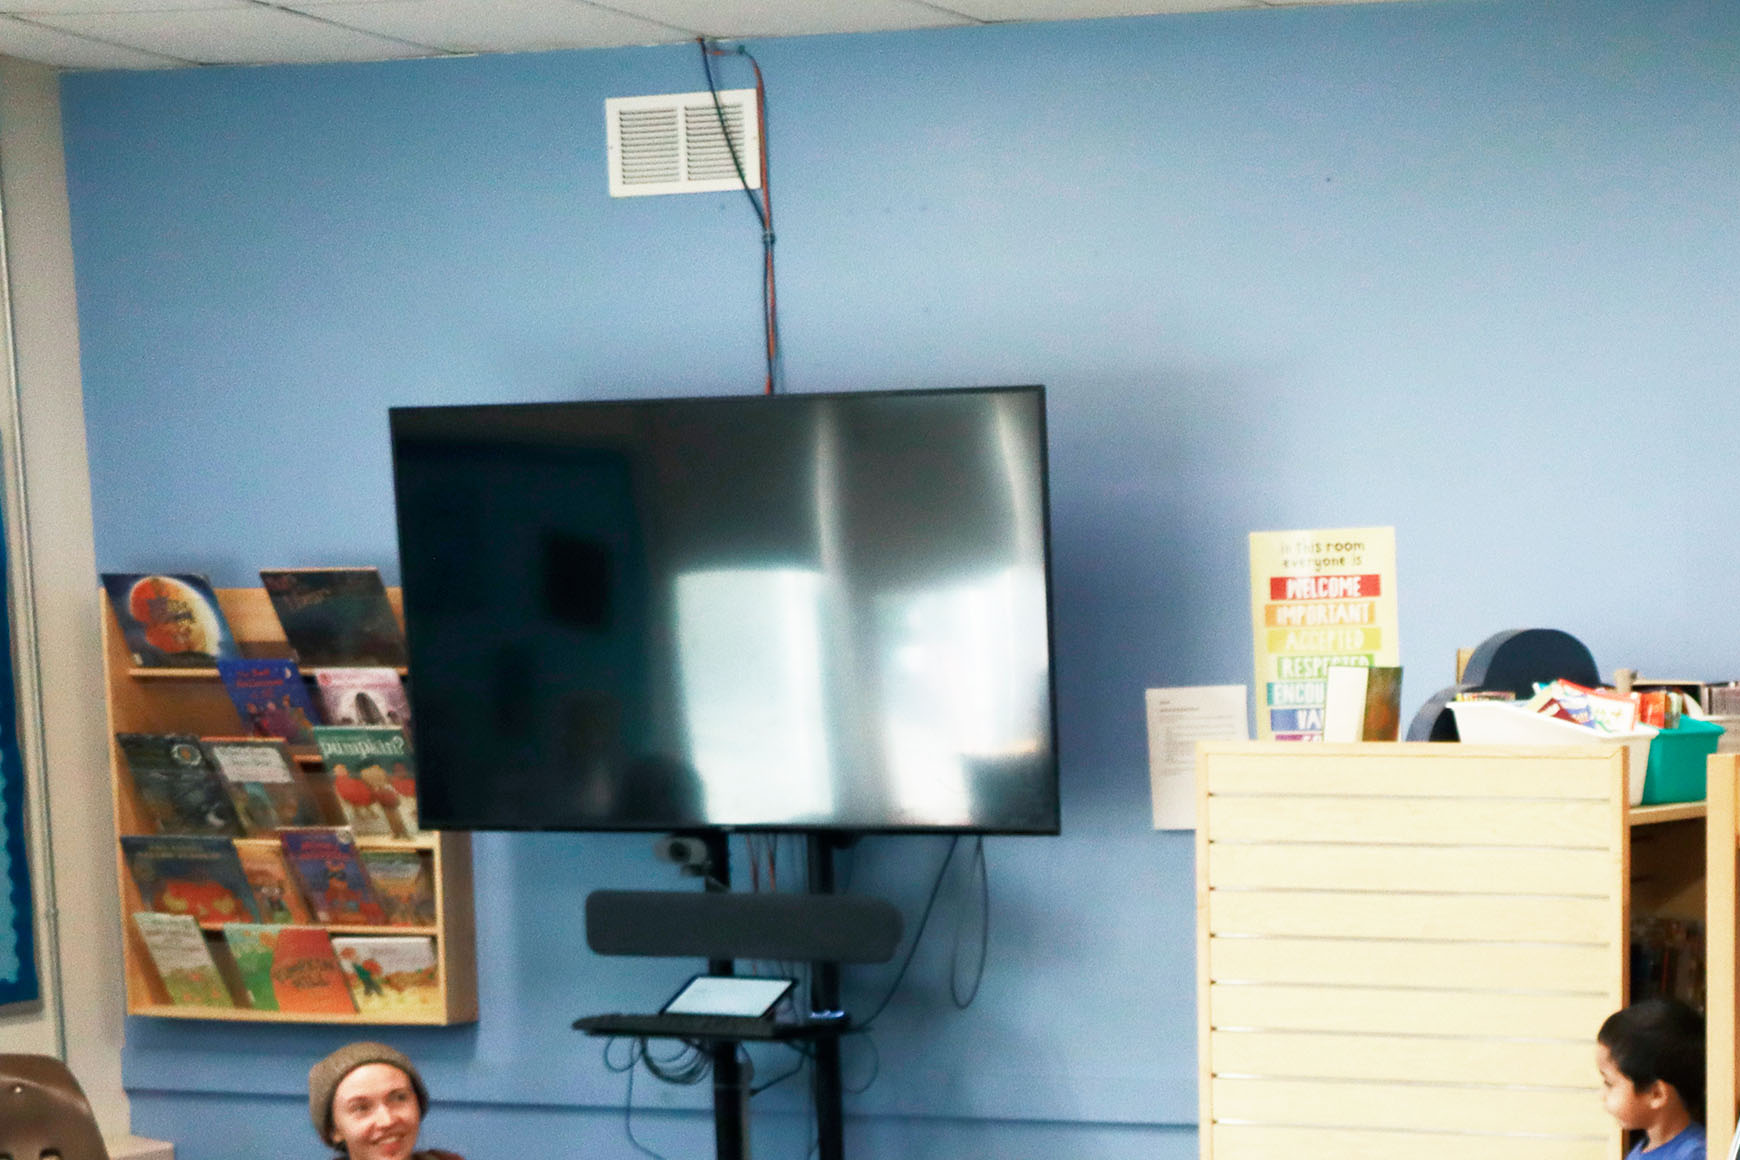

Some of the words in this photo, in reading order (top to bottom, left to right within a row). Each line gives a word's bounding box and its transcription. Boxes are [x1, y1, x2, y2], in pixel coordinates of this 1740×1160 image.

[1326, 541, 1365, 553] room
[1286, 576, 1362, 599] WELCOME
[1276, 602, 1369, 625] IMPORTANT
[1285, 629, 1365, 651] ACCEPTED
[1274, 682, 1326, 705] ENCOU
